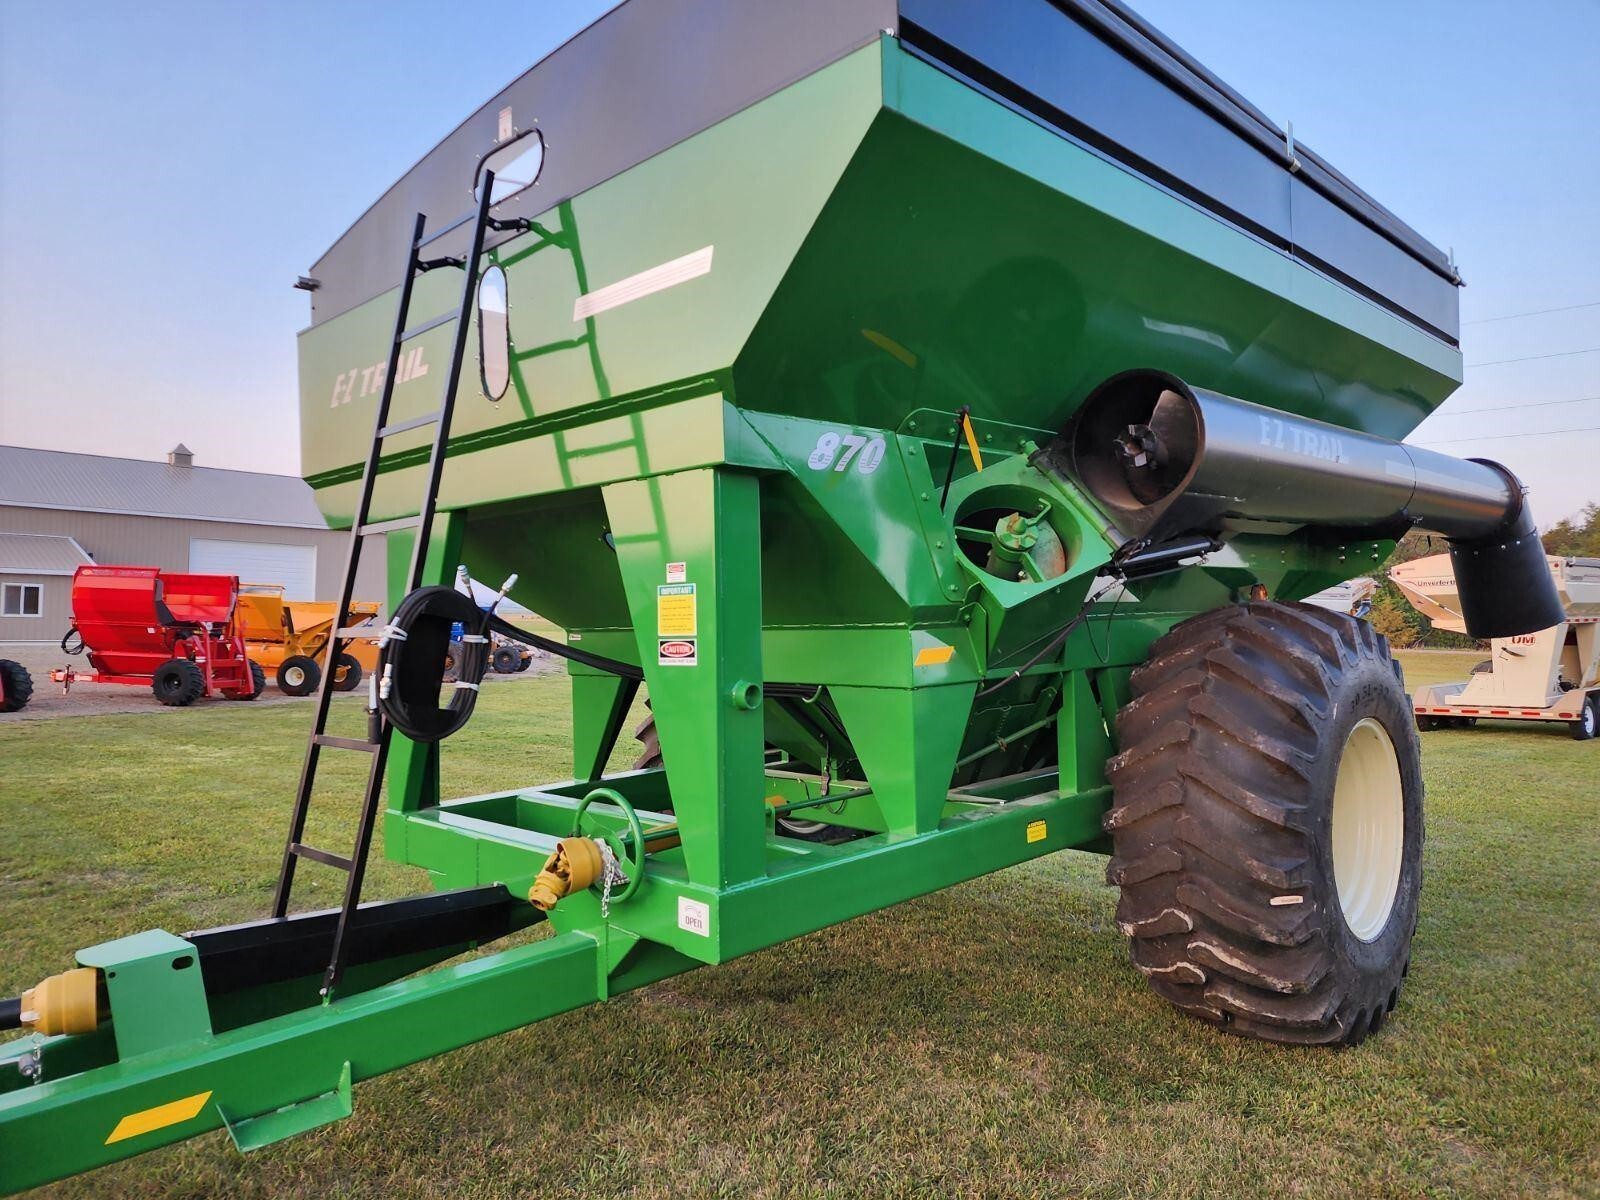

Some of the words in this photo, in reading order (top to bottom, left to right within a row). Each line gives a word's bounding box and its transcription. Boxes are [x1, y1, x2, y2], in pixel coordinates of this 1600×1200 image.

[330, 367, 358, 409] EZ
[807, 431, 886, 475] 870
[1259, 414, 1285, 450] EZ
[1289, 426, 1349, 465] TRAIL
[685, 915, 703, 929] OPEN
